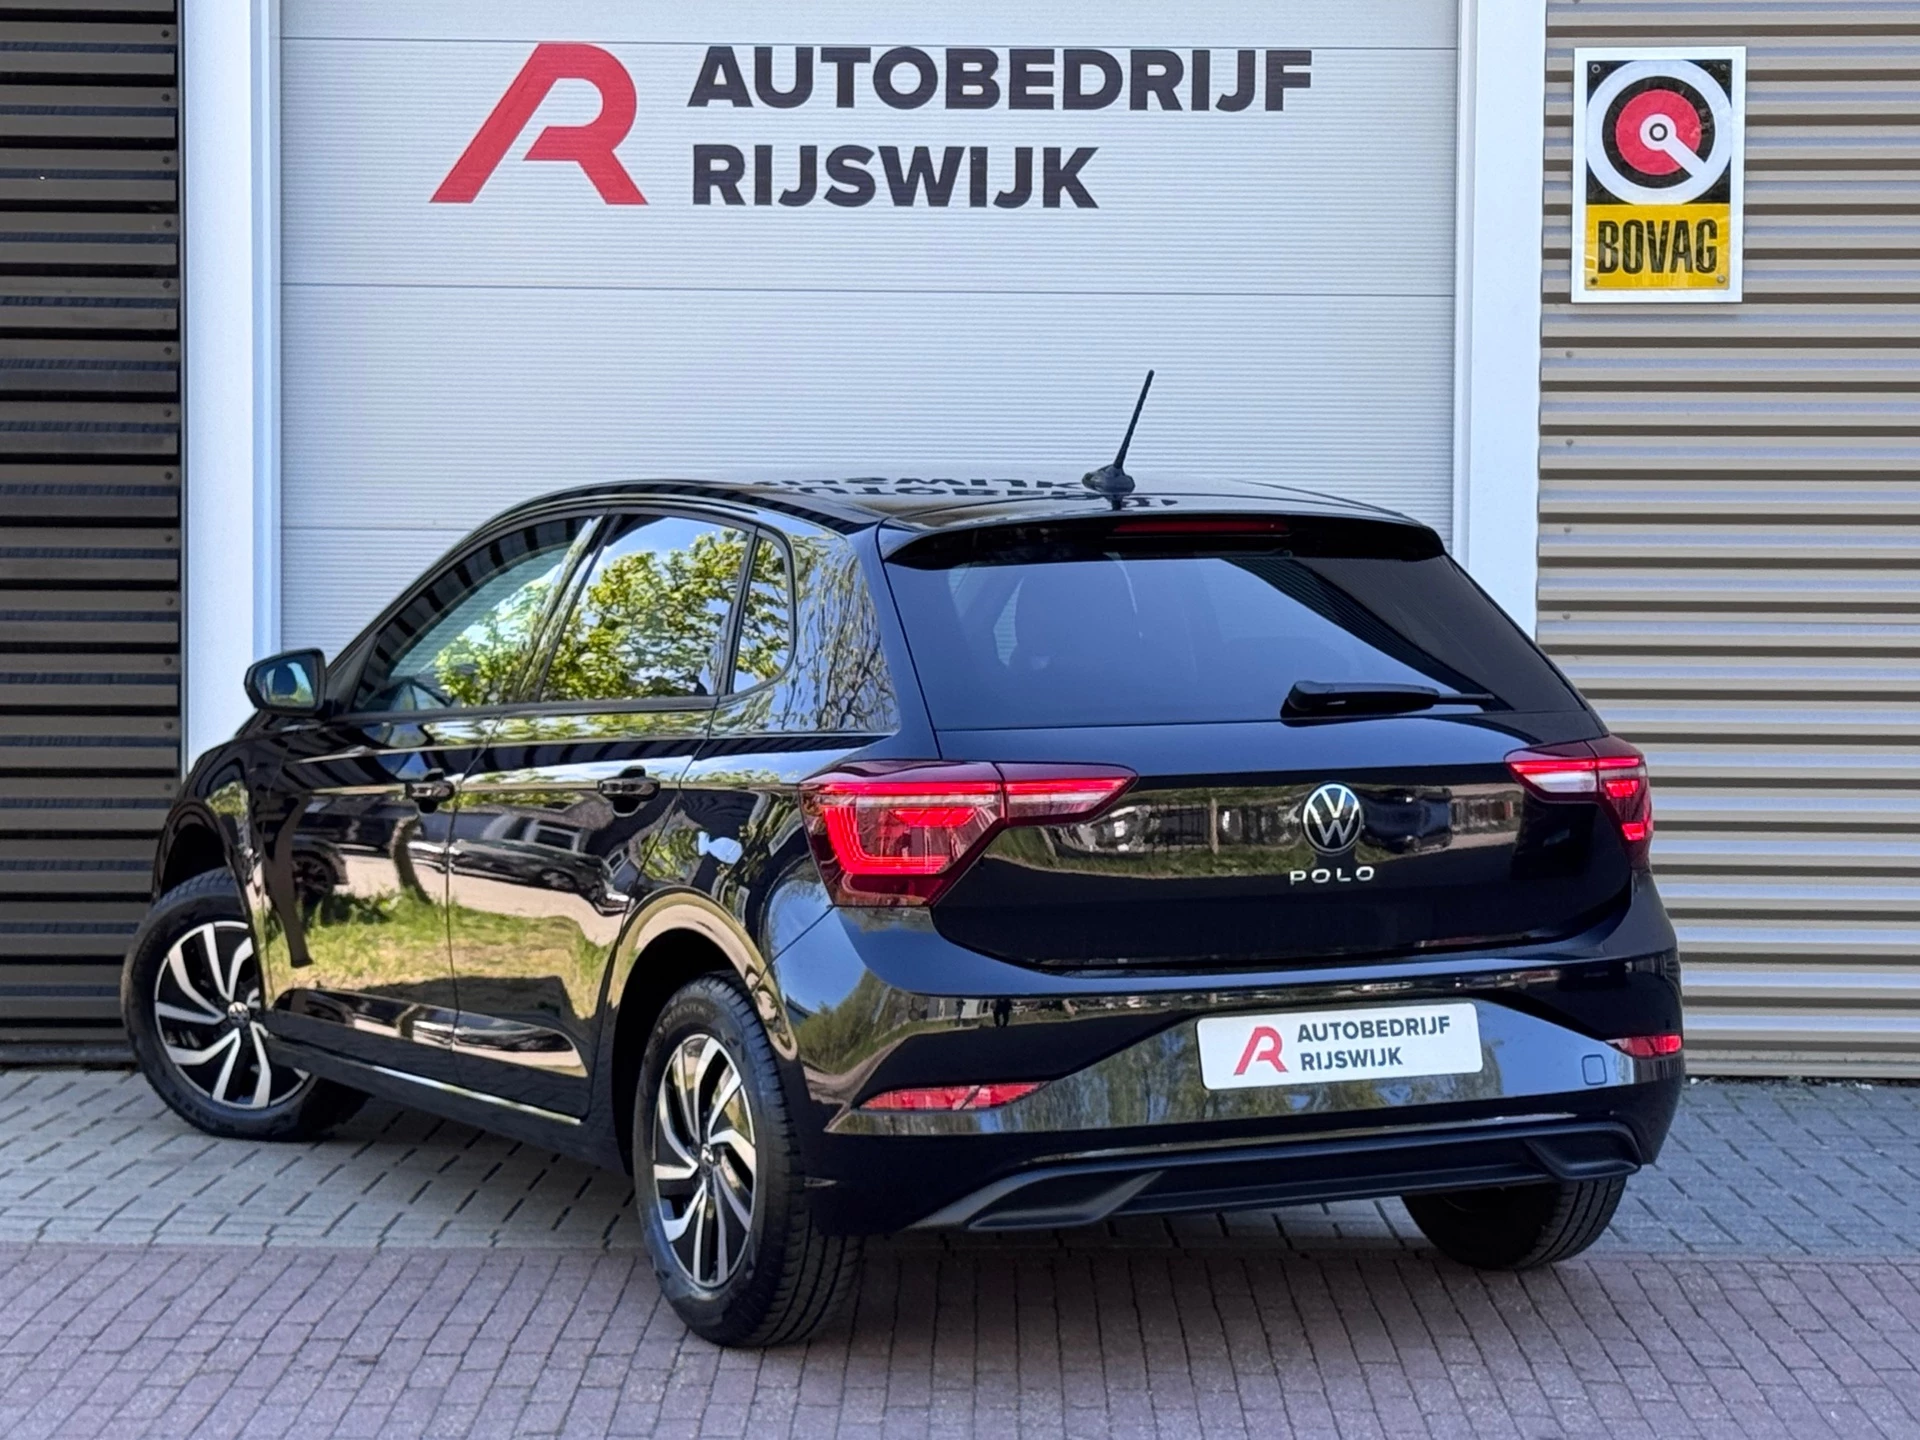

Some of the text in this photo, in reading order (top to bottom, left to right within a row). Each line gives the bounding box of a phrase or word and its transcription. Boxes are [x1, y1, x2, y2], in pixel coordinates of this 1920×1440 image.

[687, 46, 1312, 112] AUTOBEDRIJF
[692, 144, 1100, 208] RIJSWIJK
[1597, 219, 1718, 275] BOVAG
[1289, 865, 1375, 885] POLO
[1297, 1015, 1451, 1043] AUTOBEDRIJF
[1300, 1046, 1403, 1072] RIJSWIJK
